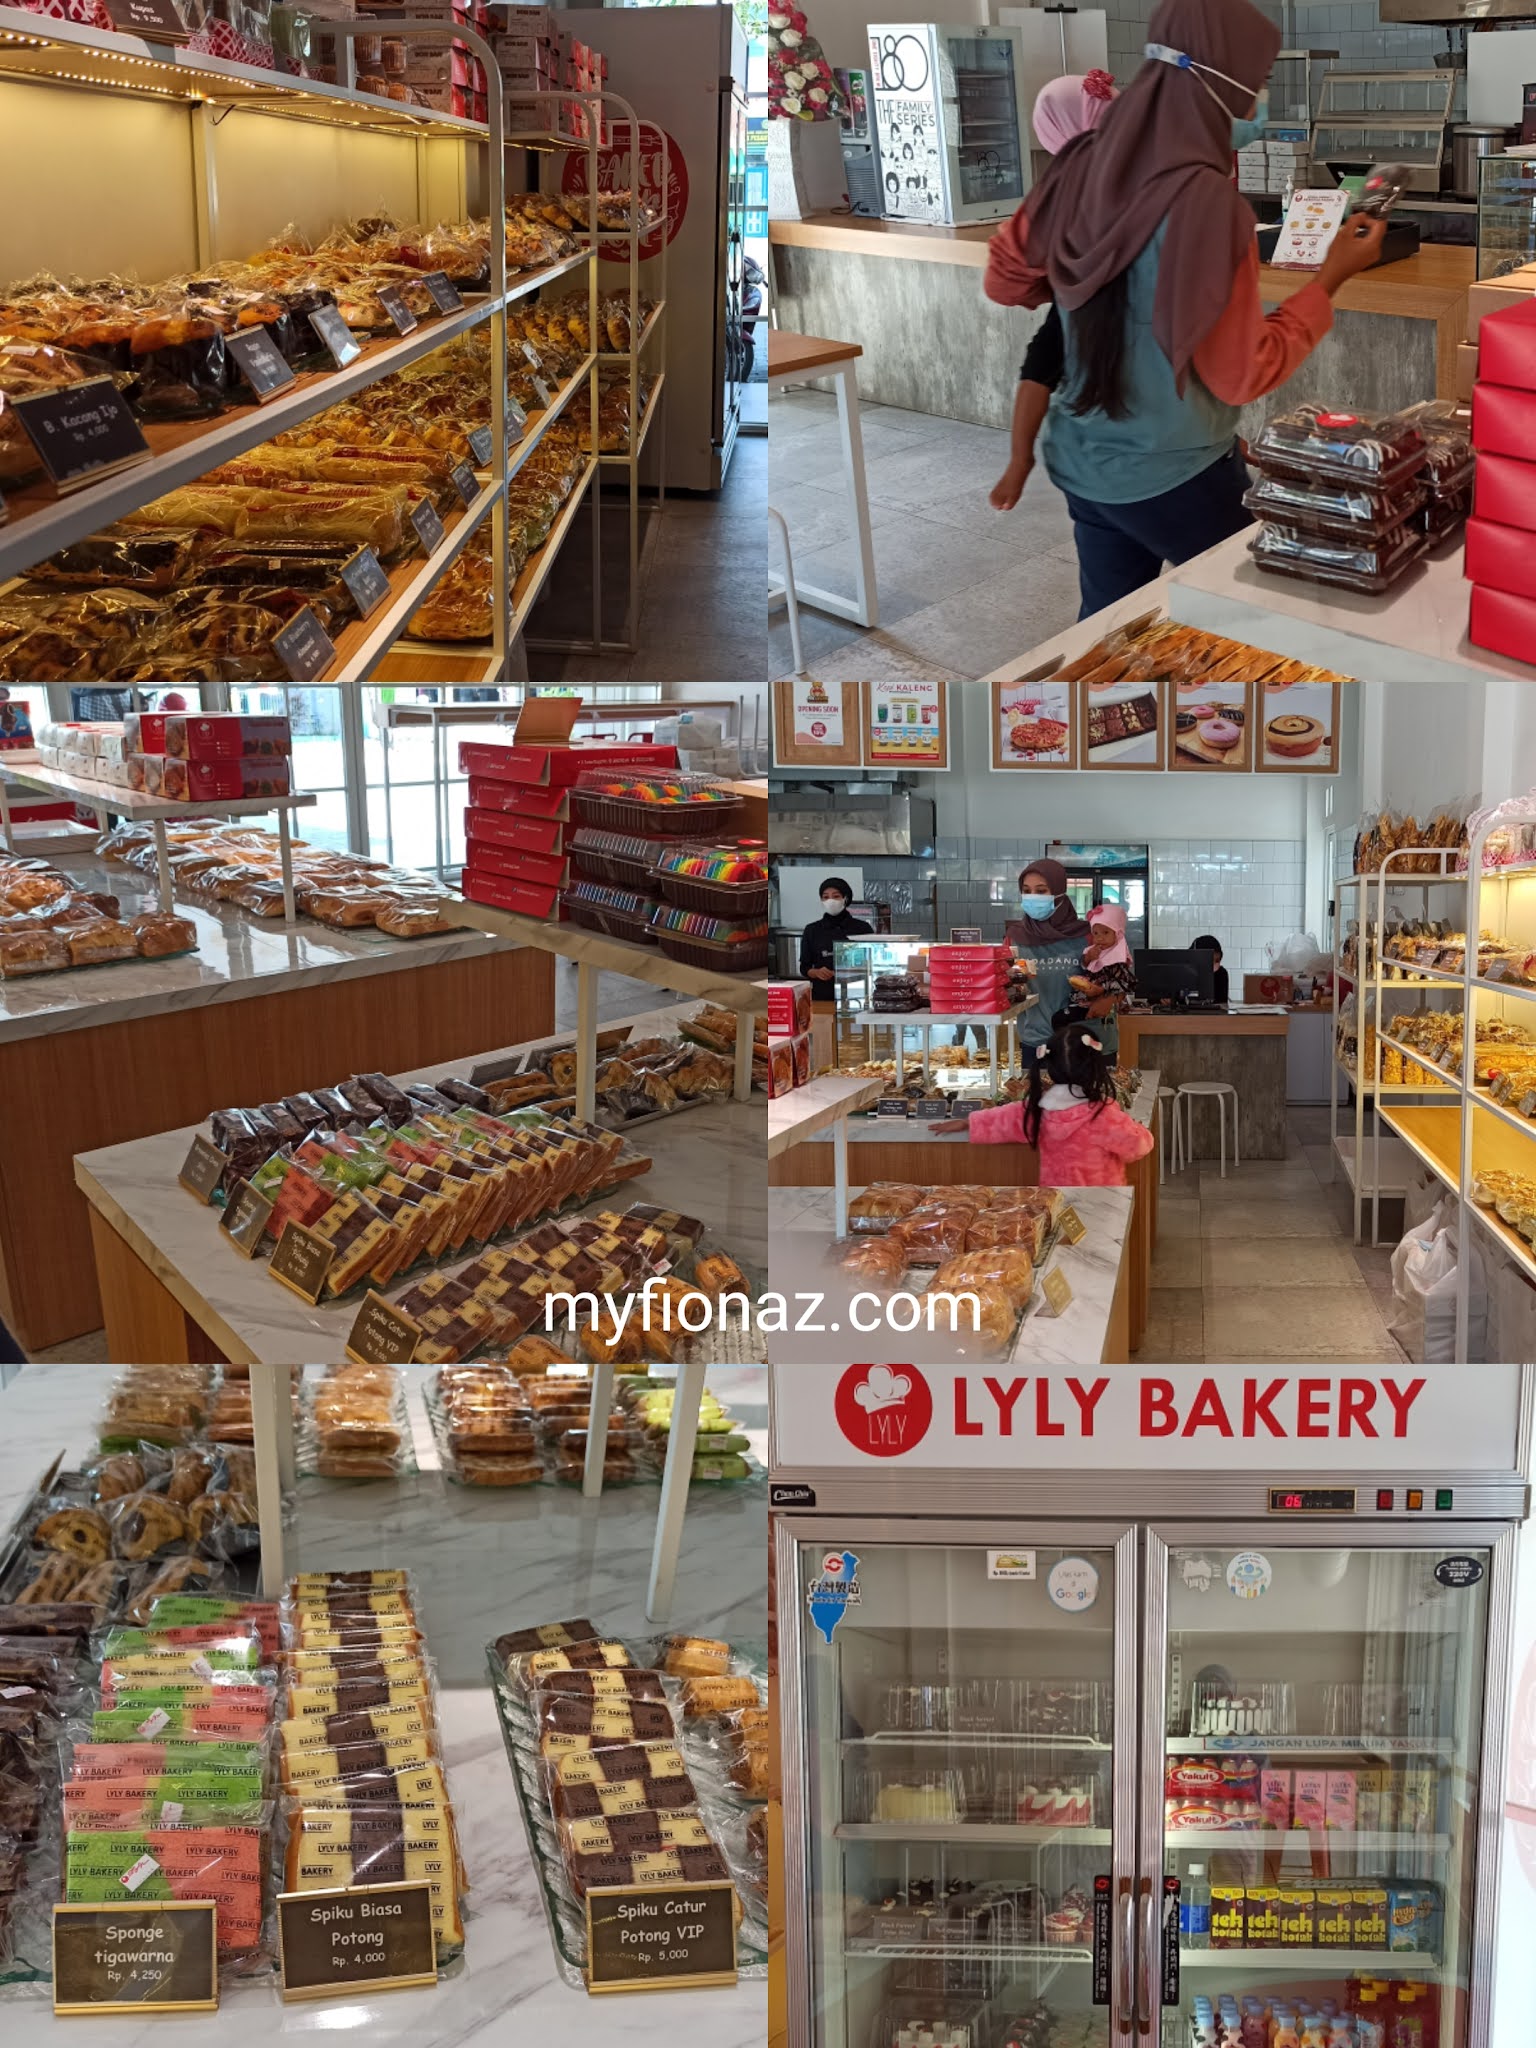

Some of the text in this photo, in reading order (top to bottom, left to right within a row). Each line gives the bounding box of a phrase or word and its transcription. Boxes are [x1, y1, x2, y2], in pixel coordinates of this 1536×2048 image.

[869, 34, 929, 91] 180
[897, 101, 931, 113] FAMILY
[896, 114, 936, 127] SERIES
[60, 410, 101, 429] Kacang
[369, 1308, 407, 1339] Spiku Catur
[364, 1323, 386, 1347] Potong
[954, 1377, 1427, 1438] LYLY BAKERY
[867, 1412, 908, 1447] LYLY
[1055, 1588, 1092, 1601] Google
[303, 1706, 330, 1714] BAKERY
[389, 1705, 416, 1713] BAKERY
[407, 1722, 421, 1730] LYLY
[362, 1727, 389, 1737] BAKERY
[299, 1736, 327, 1745] BAKERY
[647, 1744, 673, 1753] BAKERY
[667, 1760, 681, 1768] LYLY
[91, 1767, 122, 1775] BAKERY
[142, 1767, 193, 1775] LYLY BAKERY
[214, 1768, 231, 1776] LYLY
[291, 1769, 320, 1778] BAKERY
[564, 1772, 590, 1780] BAKERY
[1181, 1771, 1217, 1782] Yakult
[314, 1778, 330, 1786] LYLY
[416, 1780, 432, 1789] LYLY
[106, 1790, 157, 1798] LYLY BAKERY
[178, 1790, 228, 1798] LYLY BAKERY
[351, 1787, 398, 1799] LYLY BAKERY
[599, 1785, 627, 1795] BAKERY
[619, 1802, 635, 1811] LYLY
[1183, 1815, 1219, 1826] Yakult
[225, 1826, 242, 1834] LYLY
[302, 1823, 332, 1831] BAKERY
[645, 1831, 674, 1841] BAKERY
[407, 1841, 438, 1850] BAKERY
[580, 1837, 610, 1847] BAKERY
[110, 1844, 164, 1854] LYLY BAKERY
[186, 1847, 239, 1857] LYLY BAKERY
[318, 1844, 368, 1852] LYLY BAKERY
[600, 1854, 648, 1866] LYLY BAKERY
[69, 1867, 124, 1876] LYLY BAKERY
[301, 1867, 333, 1875] BAKERY
[425, 1863, 441, 1871] LYLY
[165, 1869, 200, 1877] BAKERY
[221, 1871, 238, 1880] LYLY
[640, 1869, 686, 1880] LYLY BAKERY
[104, 1891, 159, 1899] LYLY BAKERY
[182, 1892, 199, 1900] LYLY
[310, 1903, 402, 1925] Spiku Biasa
[617, 1901, 706, 1921] Spiku Catur
[1212, 1908, 1243, 1927] teh
[1248, 1909, 1279, 1928] teh
[1282, 1912, 1312, 1932] teh
[1319, 1912, 1350, 1932] teh
[1355, 1912, 1386, 1932] teh
[105, 1926, 164, 1943] Sponge
[621, 1925, 704, 1945] Potong VIP
[1211, 1927, 1243, 1939] kotak
[1248, 1928, 1279, 1939] kotak
[1281, 1932, 1313, 1943] kotak
[1318, 1932, 1350, 1943] kotak
[1354, 1932, 1386, 1943] kotak
[332, 1932, 384, 1947] Potong
[94, 1951, 174, 1967] tigawarna
[332, 1952, 386, 1968] Rp. 4,000
[638, 1950, 688, 1963] Rp. 5,000
[107, 1970, 162, 1983] Rp. 4,250
